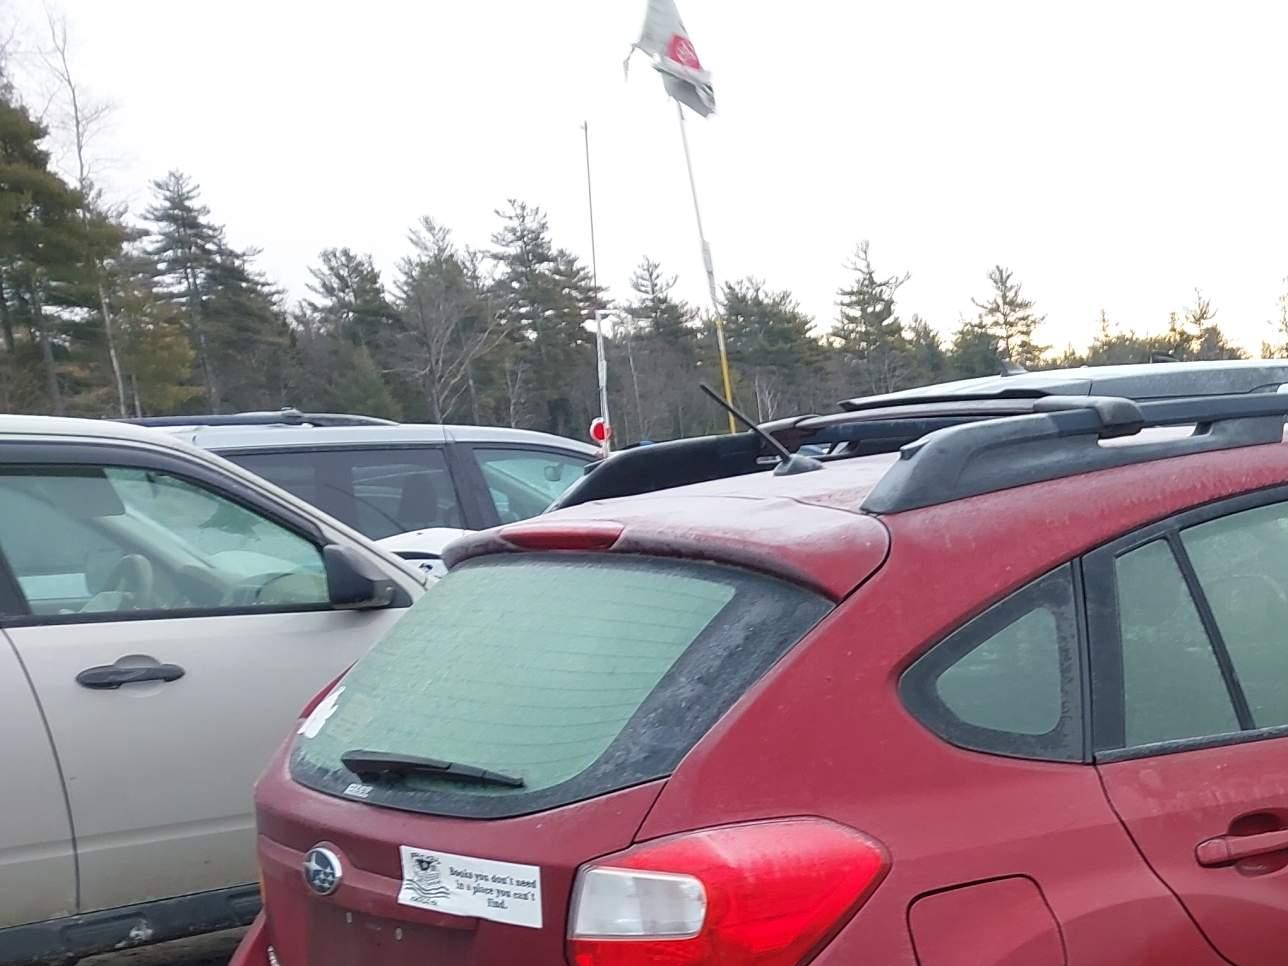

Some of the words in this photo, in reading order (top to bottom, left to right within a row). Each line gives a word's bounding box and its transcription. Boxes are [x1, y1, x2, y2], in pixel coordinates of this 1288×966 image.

[456, 879, 465, 890] in
[472, 883, 495, 896] place
[495, 888, 512, 899] you
[513, 891, 536, 901] can't
[474, 872, 490, 883] you
[491, 874, 514, 886] don't
[515, 879, 537, 889] need
